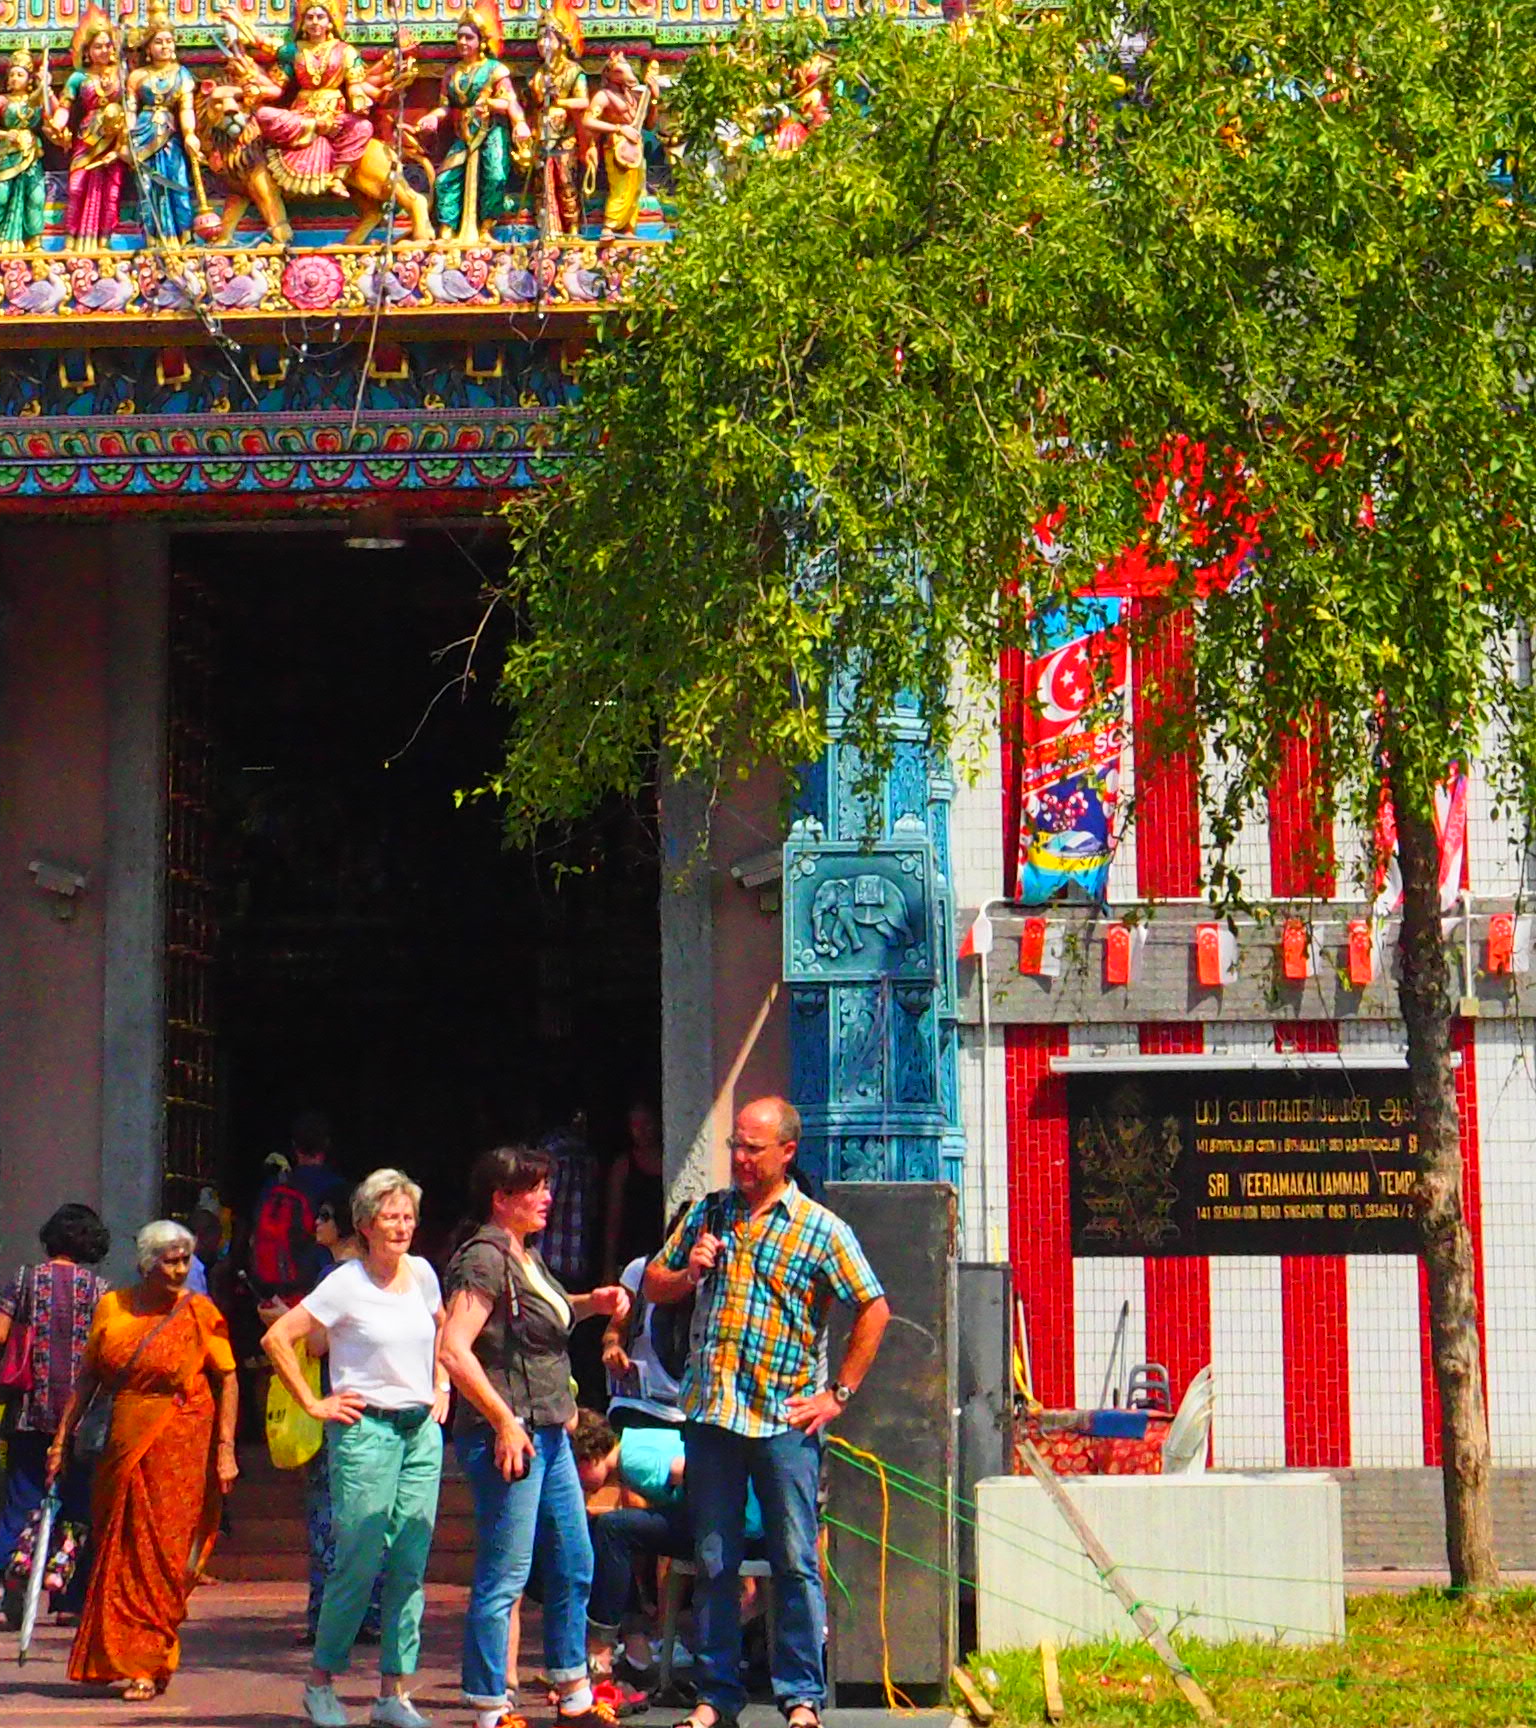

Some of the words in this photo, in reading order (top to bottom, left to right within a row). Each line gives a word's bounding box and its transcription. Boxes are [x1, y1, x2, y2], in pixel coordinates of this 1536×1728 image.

[1208, 1172, 1230, 1198] SRI
[1239, 1170, 1370, 1198] VEERAMAKALIAMMAN
[1379, 1170, 1417, 1196] TEMP
